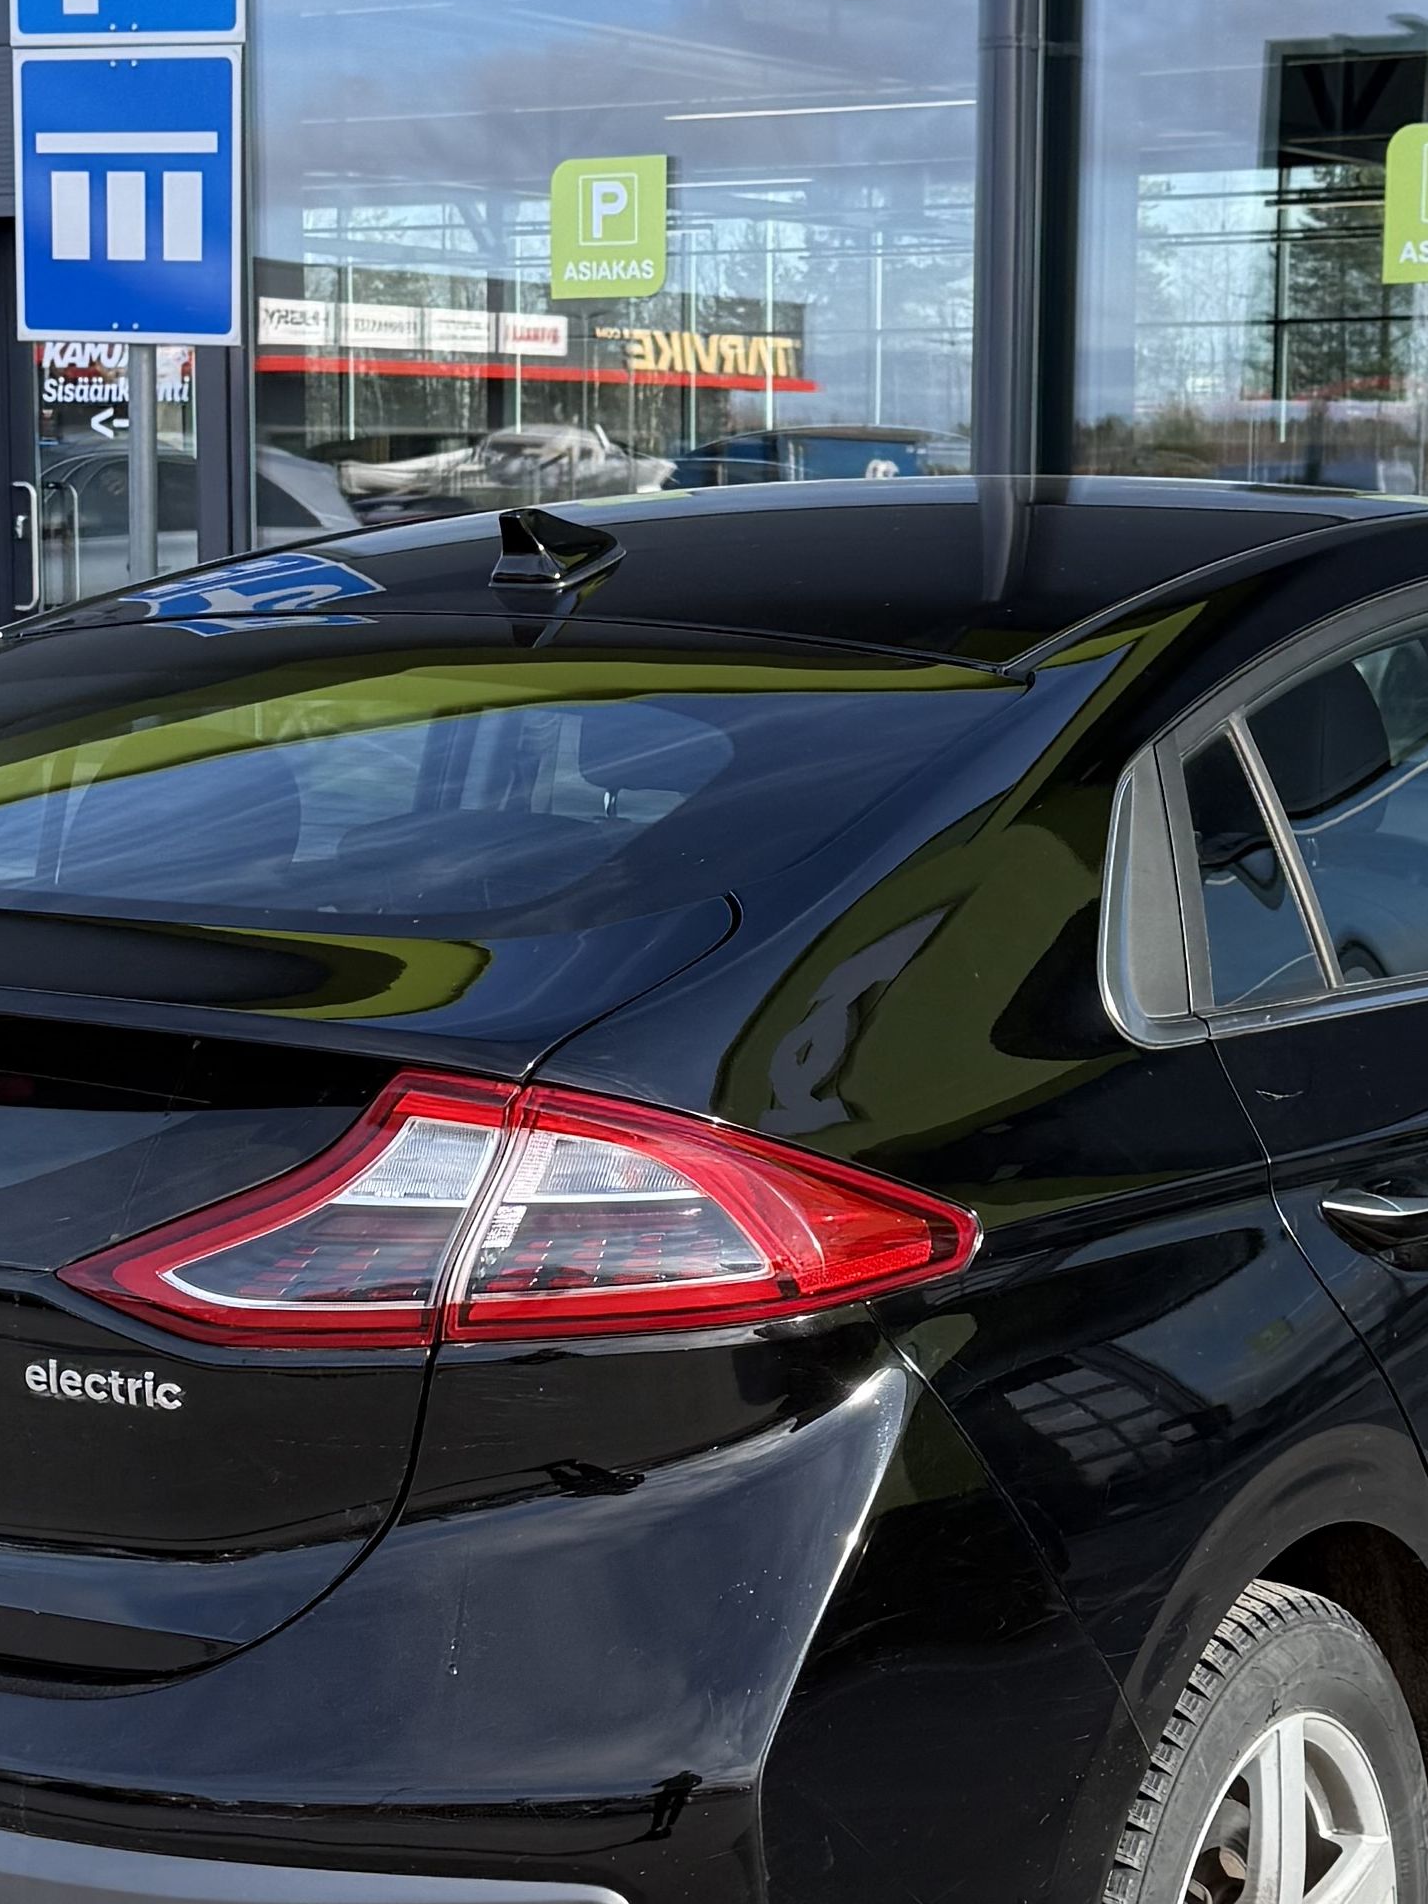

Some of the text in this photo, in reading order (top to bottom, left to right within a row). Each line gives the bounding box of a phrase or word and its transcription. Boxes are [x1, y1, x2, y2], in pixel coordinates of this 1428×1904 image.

[592, 181, 629, 239] P
[563, 258, 655, 283] ASIAKAS
[42, 376, 190, 403] Sisäänknti
[24, 1358, 184, 1412] electric
